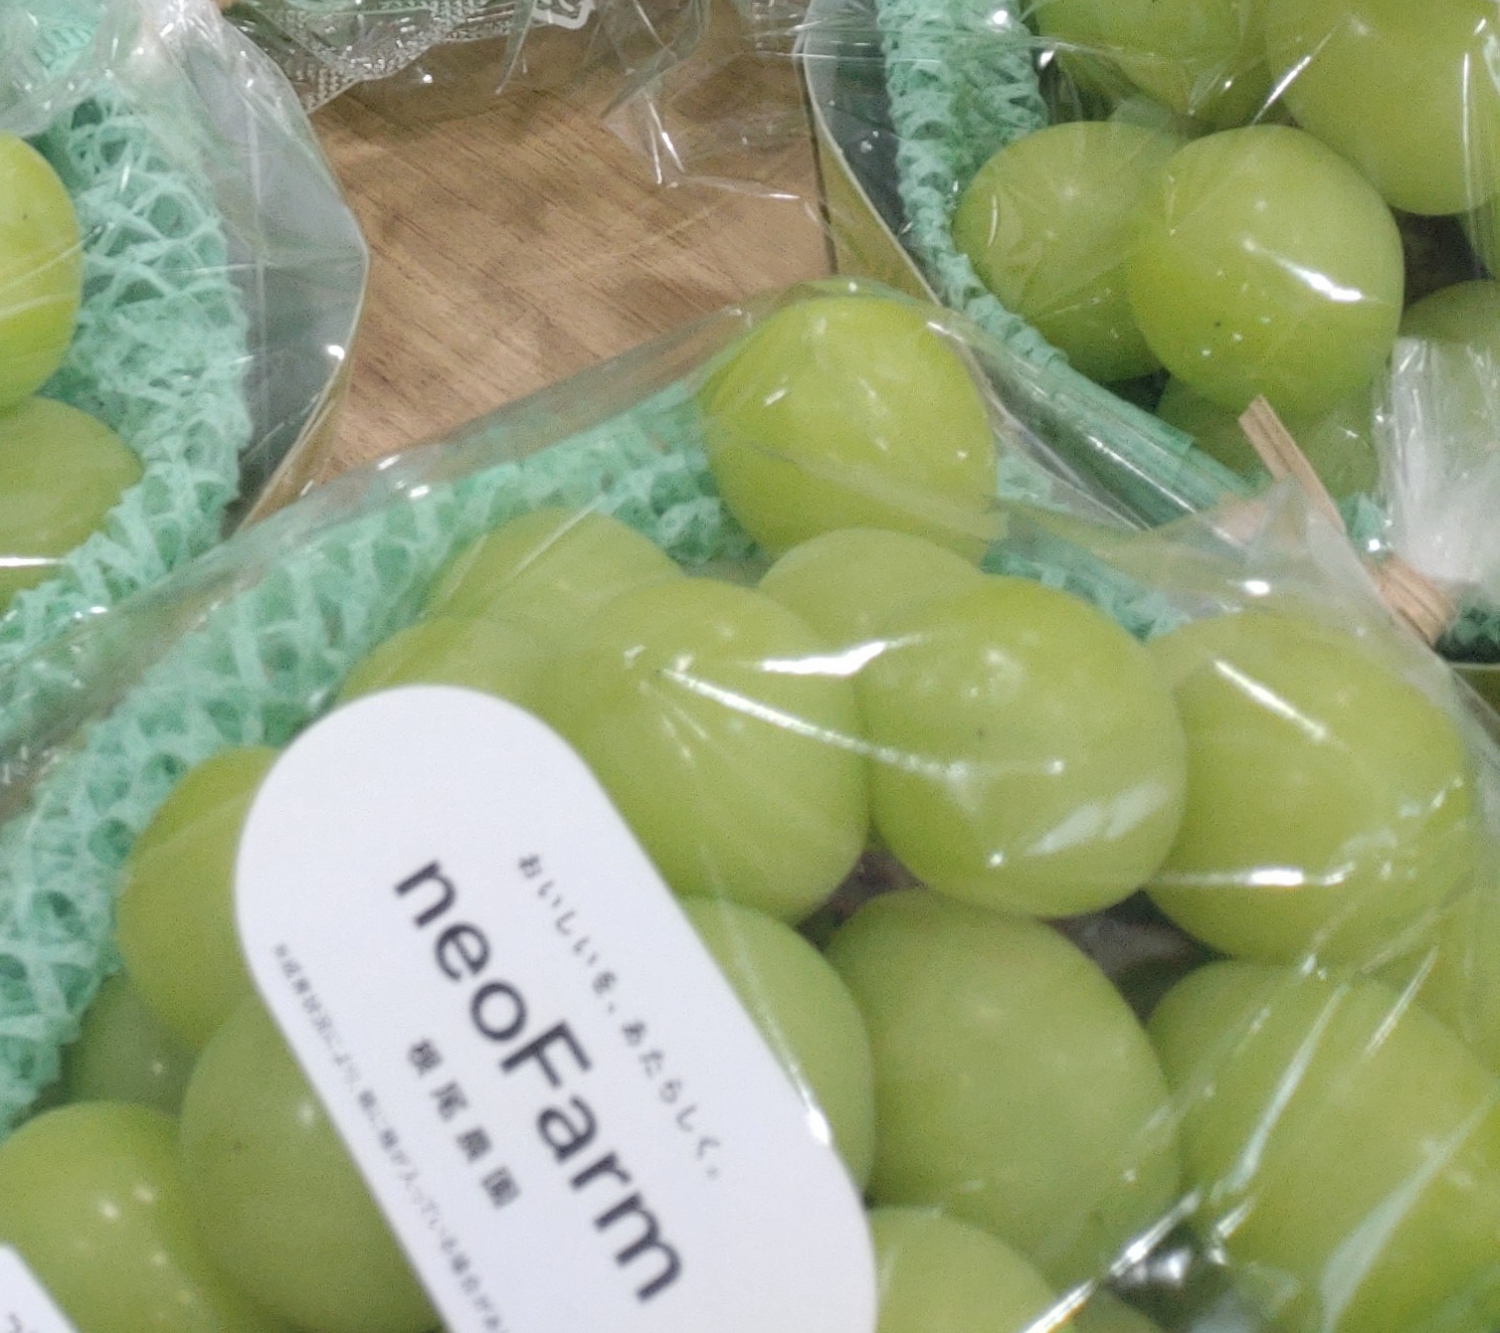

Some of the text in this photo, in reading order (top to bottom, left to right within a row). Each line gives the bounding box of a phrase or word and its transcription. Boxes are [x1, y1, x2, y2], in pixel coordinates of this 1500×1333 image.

[393, 856, 685, 1306] neoFarm
[518, 850, 721, 1181] おいしいを、あたらしく。
